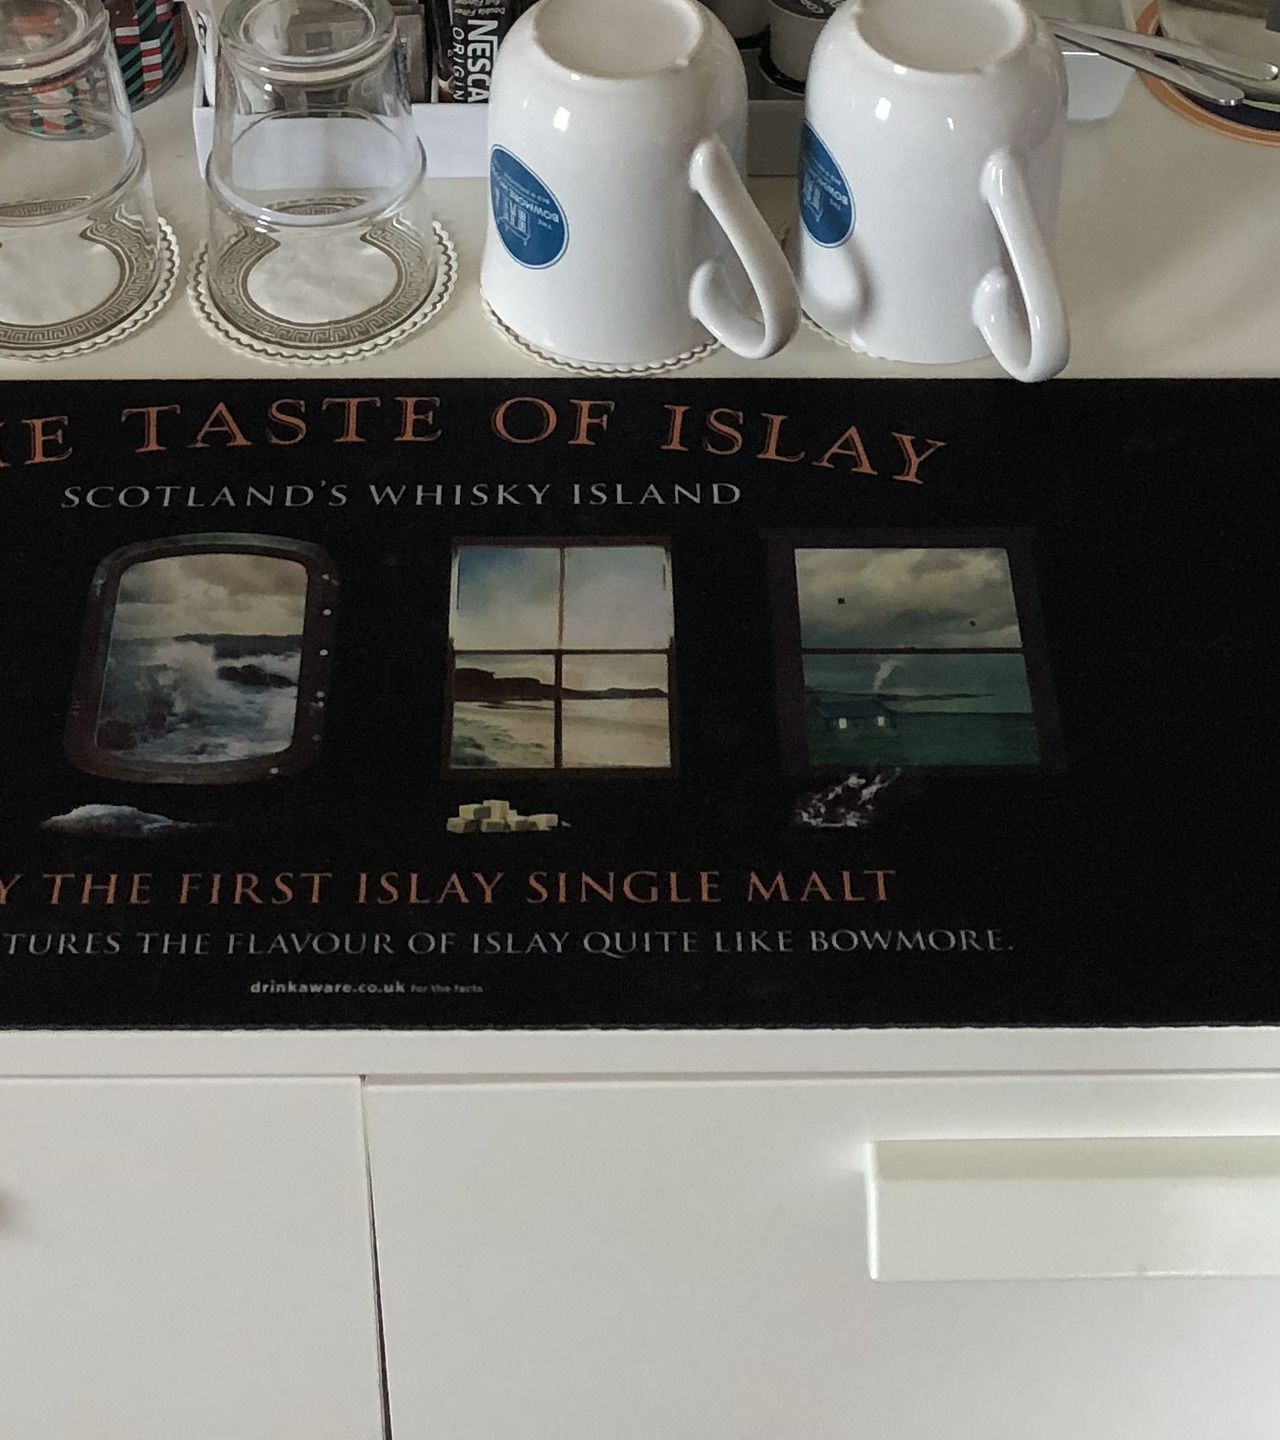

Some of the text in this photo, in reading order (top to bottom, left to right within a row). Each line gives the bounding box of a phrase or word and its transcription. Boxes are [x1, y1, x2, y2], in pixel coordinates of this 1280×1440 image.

[121, 397, 443, 453] TASTE
[491, 397, 615, 445] OF
[660, 404, 947, 484] ISLAY
[61, 480, 742, 508] SCOTLAND'S WHISKY ISLAND
[42, 872, 153, 905] THE
[178, 871, 333, 905] FIRST
[356, 871, 505, 904] ISLAY
[526, 871, 720, 903] SINGLE
[747, 870, 897, 902] MALT
[136, 932, 212, 955] THE
[226, 932, 395, 955] FLAVOUR
[407, 931, 457, 955] OF
[471, 931, 570, 954] ISLAY
[582, 930, 699, 958] QUITE
[714, 930, 794, 953] LIKE
[810, 928, 1014, 952] BOWMORE.
[249, 979, 406, 994] drinkaware.co.uk
